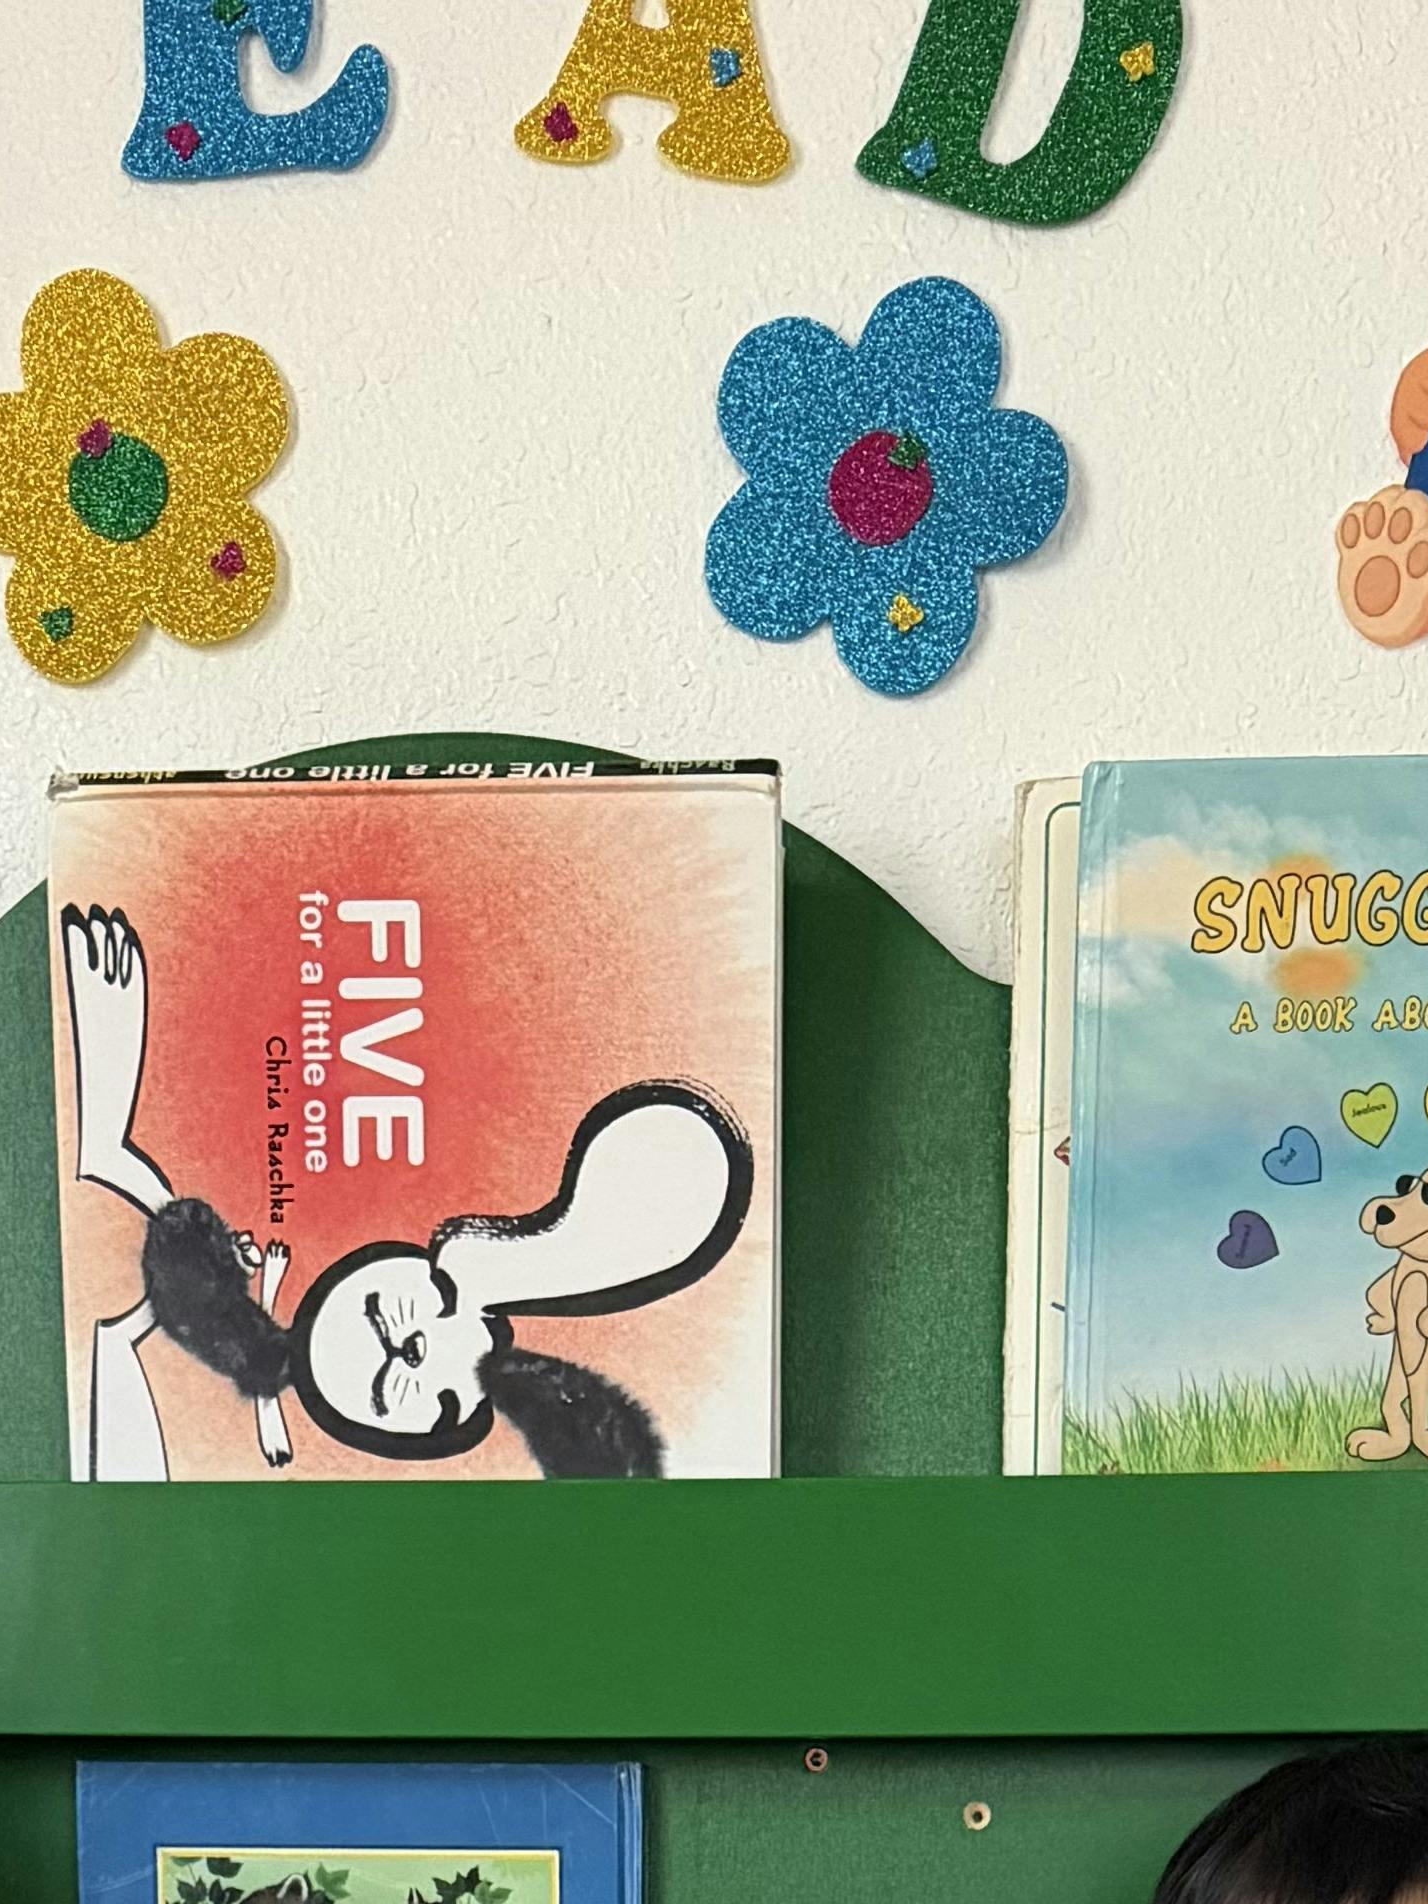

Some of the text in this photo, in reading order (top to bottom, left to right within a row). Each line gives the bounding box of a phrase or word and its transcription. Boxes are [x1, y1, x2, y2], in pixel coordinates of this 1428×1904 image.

[224, 766, 296, 780] one
[309, 765, 391, 782] little
[439, 763, 494, 779] for
[508, 761, 595, 778] FIVE
[1230, 1001, 1257, 1034] A
[1274, 997, 1355, 1032] BOOK
[298, 890, 333, 1174] for a little one
[336, 899, 426, 1168] FIVE
[264, 1036, 295, 1225] Chris Raschka
